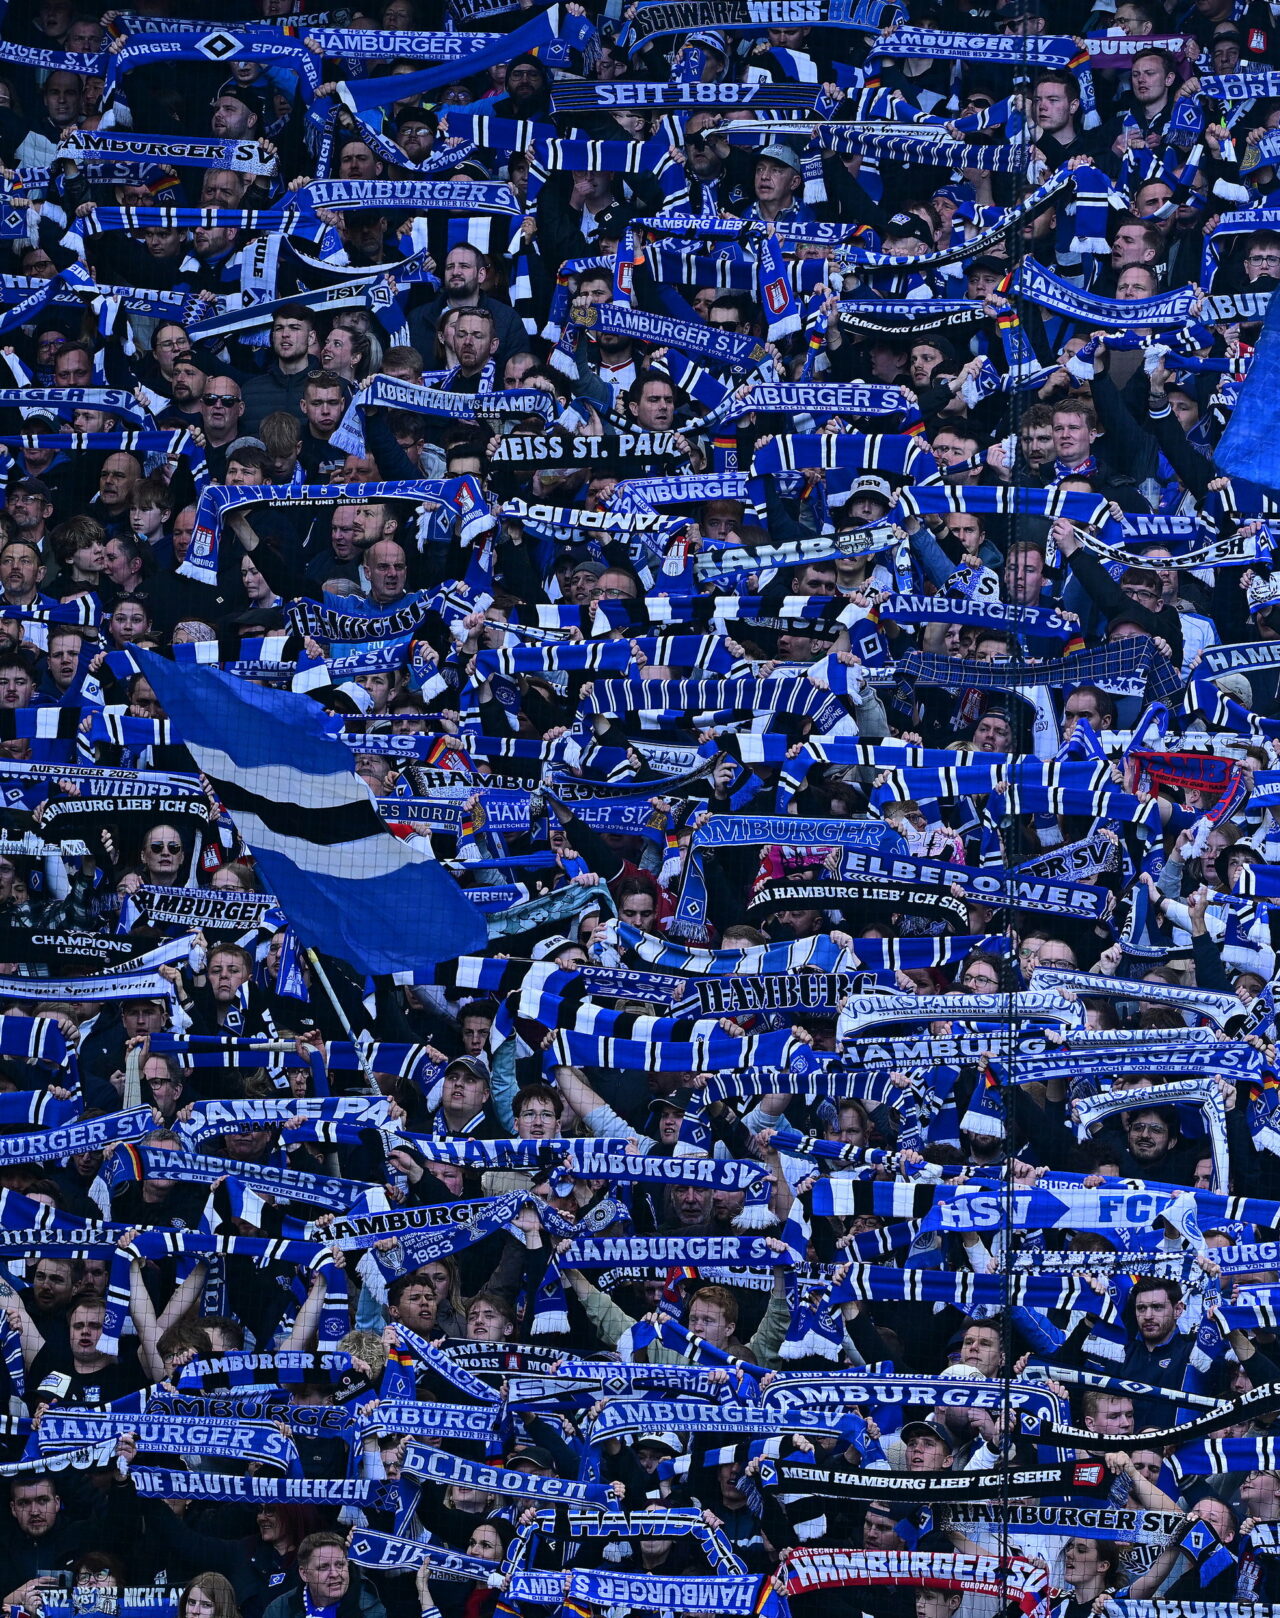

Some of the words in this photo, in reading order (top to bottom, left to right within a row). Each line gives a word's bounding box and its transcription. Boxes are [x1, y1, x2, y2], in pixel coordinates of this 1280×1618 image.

[315, 35, 460, 53] HAMBURGER
[877, 35, 1012, 50] HAMBURGER
[1024, 37, 1050, 51] SV
[598, 85, 668, 104] SEIT
[677, 83, 760, 104] 1887
[311, 182, 485, 203] HAMBURGER
[643, 217, 710, 231] HAMBURG
[327, 286, 364, 302] HSV
[599, 308, 713, 345] HAMBURGER
[717, 337, 747, 357] S.V.
[449, 411, 501, 420] 12.07.2025
[573, 437, 607, 461] ST.
[364, 646, 400, 664] S.V.
[30, 764, 104, 777] AUFSTEIGER
[109, 770, 138, 779] 2025
[44, 799, 113, 821] HAMBURG
[118, 798, 155, 811] LIEB'
[159, 799, 184, 812] ICH
[1073, 842, 1108, 868] SV
[847, 853, 1097, 910] ELBEPOWER
[773, 886, 858, 900] HAMBURG
[863, 886, 904, 900] LIEB'
[907, 888, 934, 904] ICH
[32, 936, 132, 954] CHAMPIONS
[57, 947, 108, 959] LEAGUE
[63, 980, 156, 996] Sport-Verein
[116, 1112, 150, 1137] SV
[148, 1150, 321, 1190] HAMBURGER
[722, 1161, 757, 1189] SV
[941, 1196, 1031, 1229] HSV
[411, 1240, 454, 1265] 1983
[181, 1352, 314, 1376] HAMBURGER
[321, 1350, 349, 1371] SV
[1240, 1385, 1272, 1405] ICH
[797, 1410, 842, 1427] SV
[134, 1470, 163, 1494] DIE
[170, 1472, 246, 1498] RAUTE
[253, 1477, 281, 1499] IM
[286, 1477, 369, 1501] HERZEN
[783, 1466, 829, 1483] MEIN
[833, 1470, 926, 1491] HAMBURG
[929, 1474, 975, 1491] LIEB'
[1012, 1470, 1061, 1487] SEHR
[951, 1505, 1134, 1530] HAMBURGER
[1143, 1512, 1181, 1535] SV
[124, 1587, 166, 1608] NICHT
